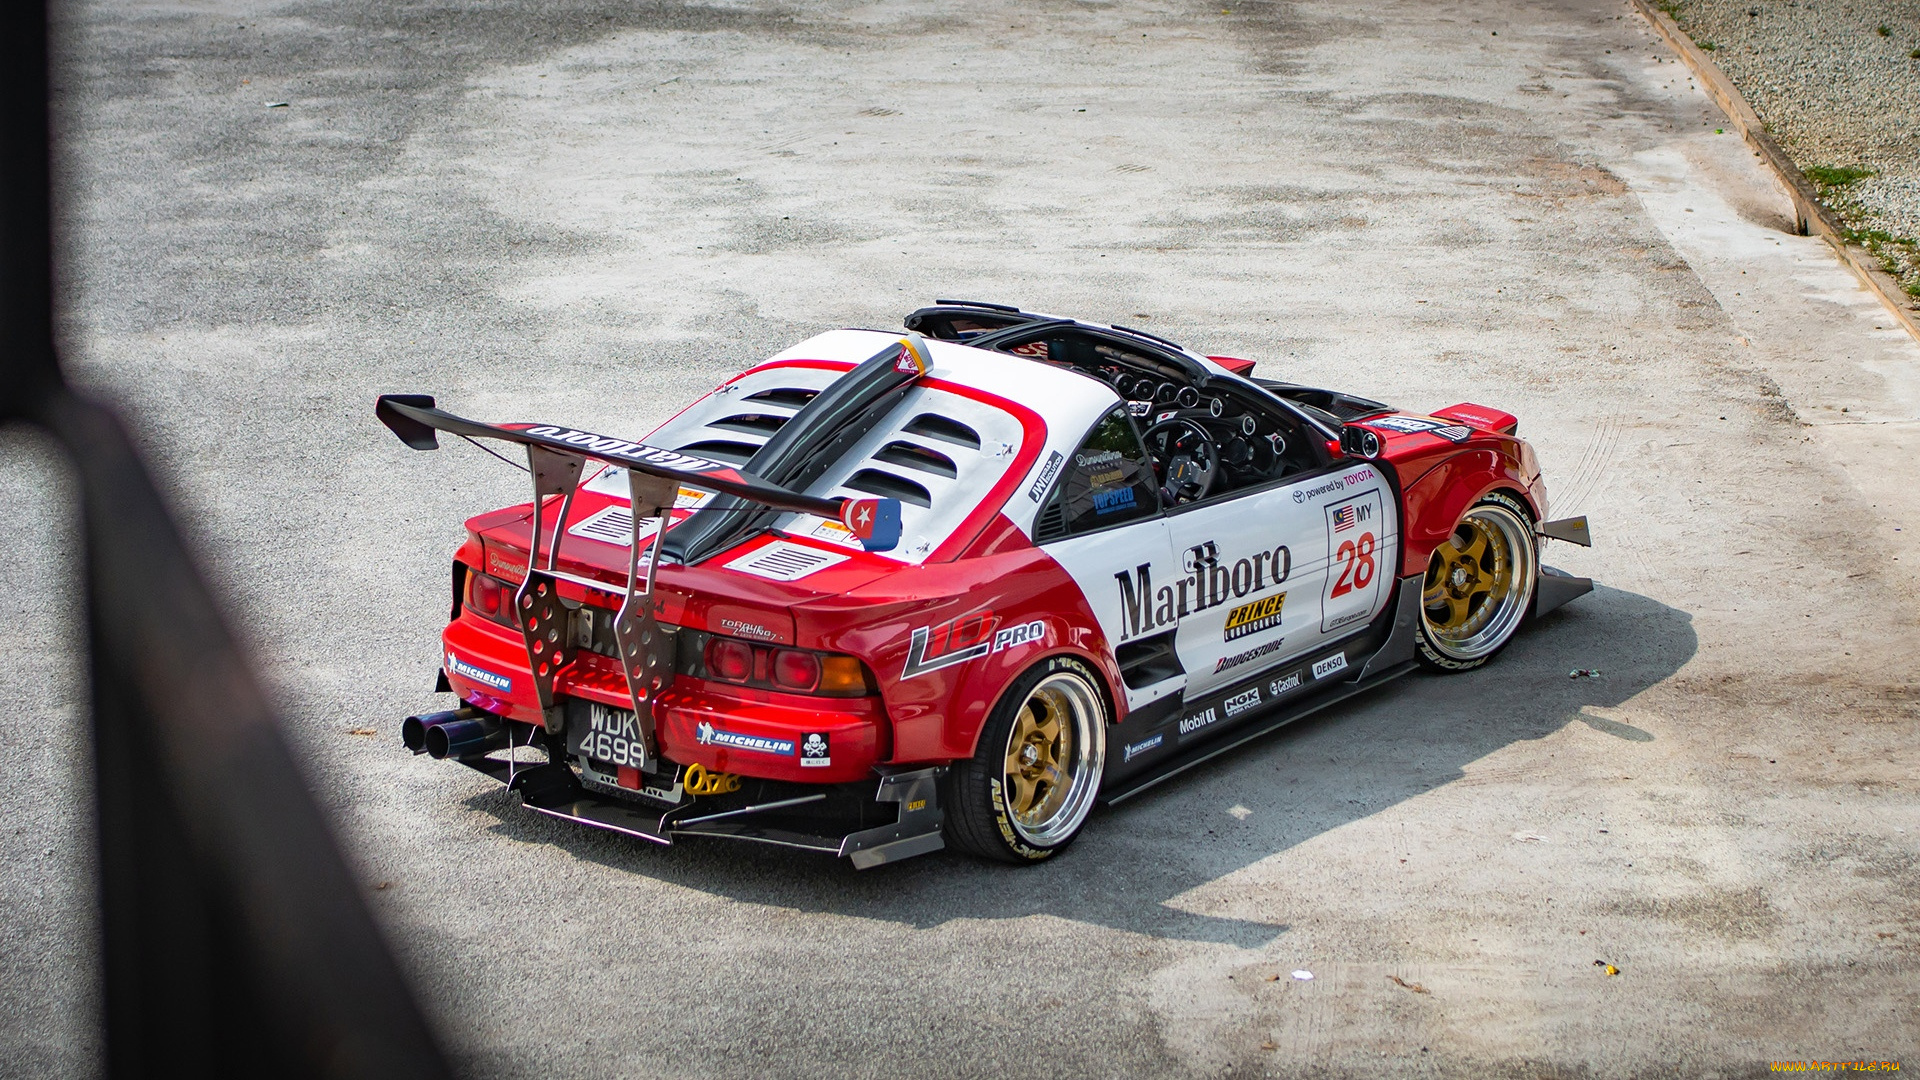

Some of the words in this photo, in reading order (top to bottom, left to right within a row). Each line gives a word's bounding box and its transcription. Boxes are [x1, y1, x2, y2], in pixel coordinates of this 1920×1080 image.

[526, 426, 720, 471] Marlboro
[1306, 480, 1334, 500] powered
[1334, 479, 1344, 492] by
[1343, 469, 1374, 486] TOYOTA
[1356, 503, 1372, 522] MY
[1330, 531, 1375, 599] 28
[1114, 540, 1291, 641] Marlboro
[1226, 593, 1286, 627] PRINCE
[992, 620, 1045, 653] PRO
[1224, 614, 1282, 642] LUBRICANTS
[1212, 637, 1285, 675] BRIDGESTONE
[1316, 656, 1343, 675] DENSO
[458, 662, 510, 688] MICHELIN
[1277, 673, 1300, 693] Castrol
[1226, 689, 1258, 710] NGK
[590, 703, 637, 740] WDK
[1179, 712, 1206, 735] Mobil
[579, 731, 645, 769] 4699
[715, 733, 792, 751] MICHELIN
[1131, 736, 1163, 754] MICHELIN
